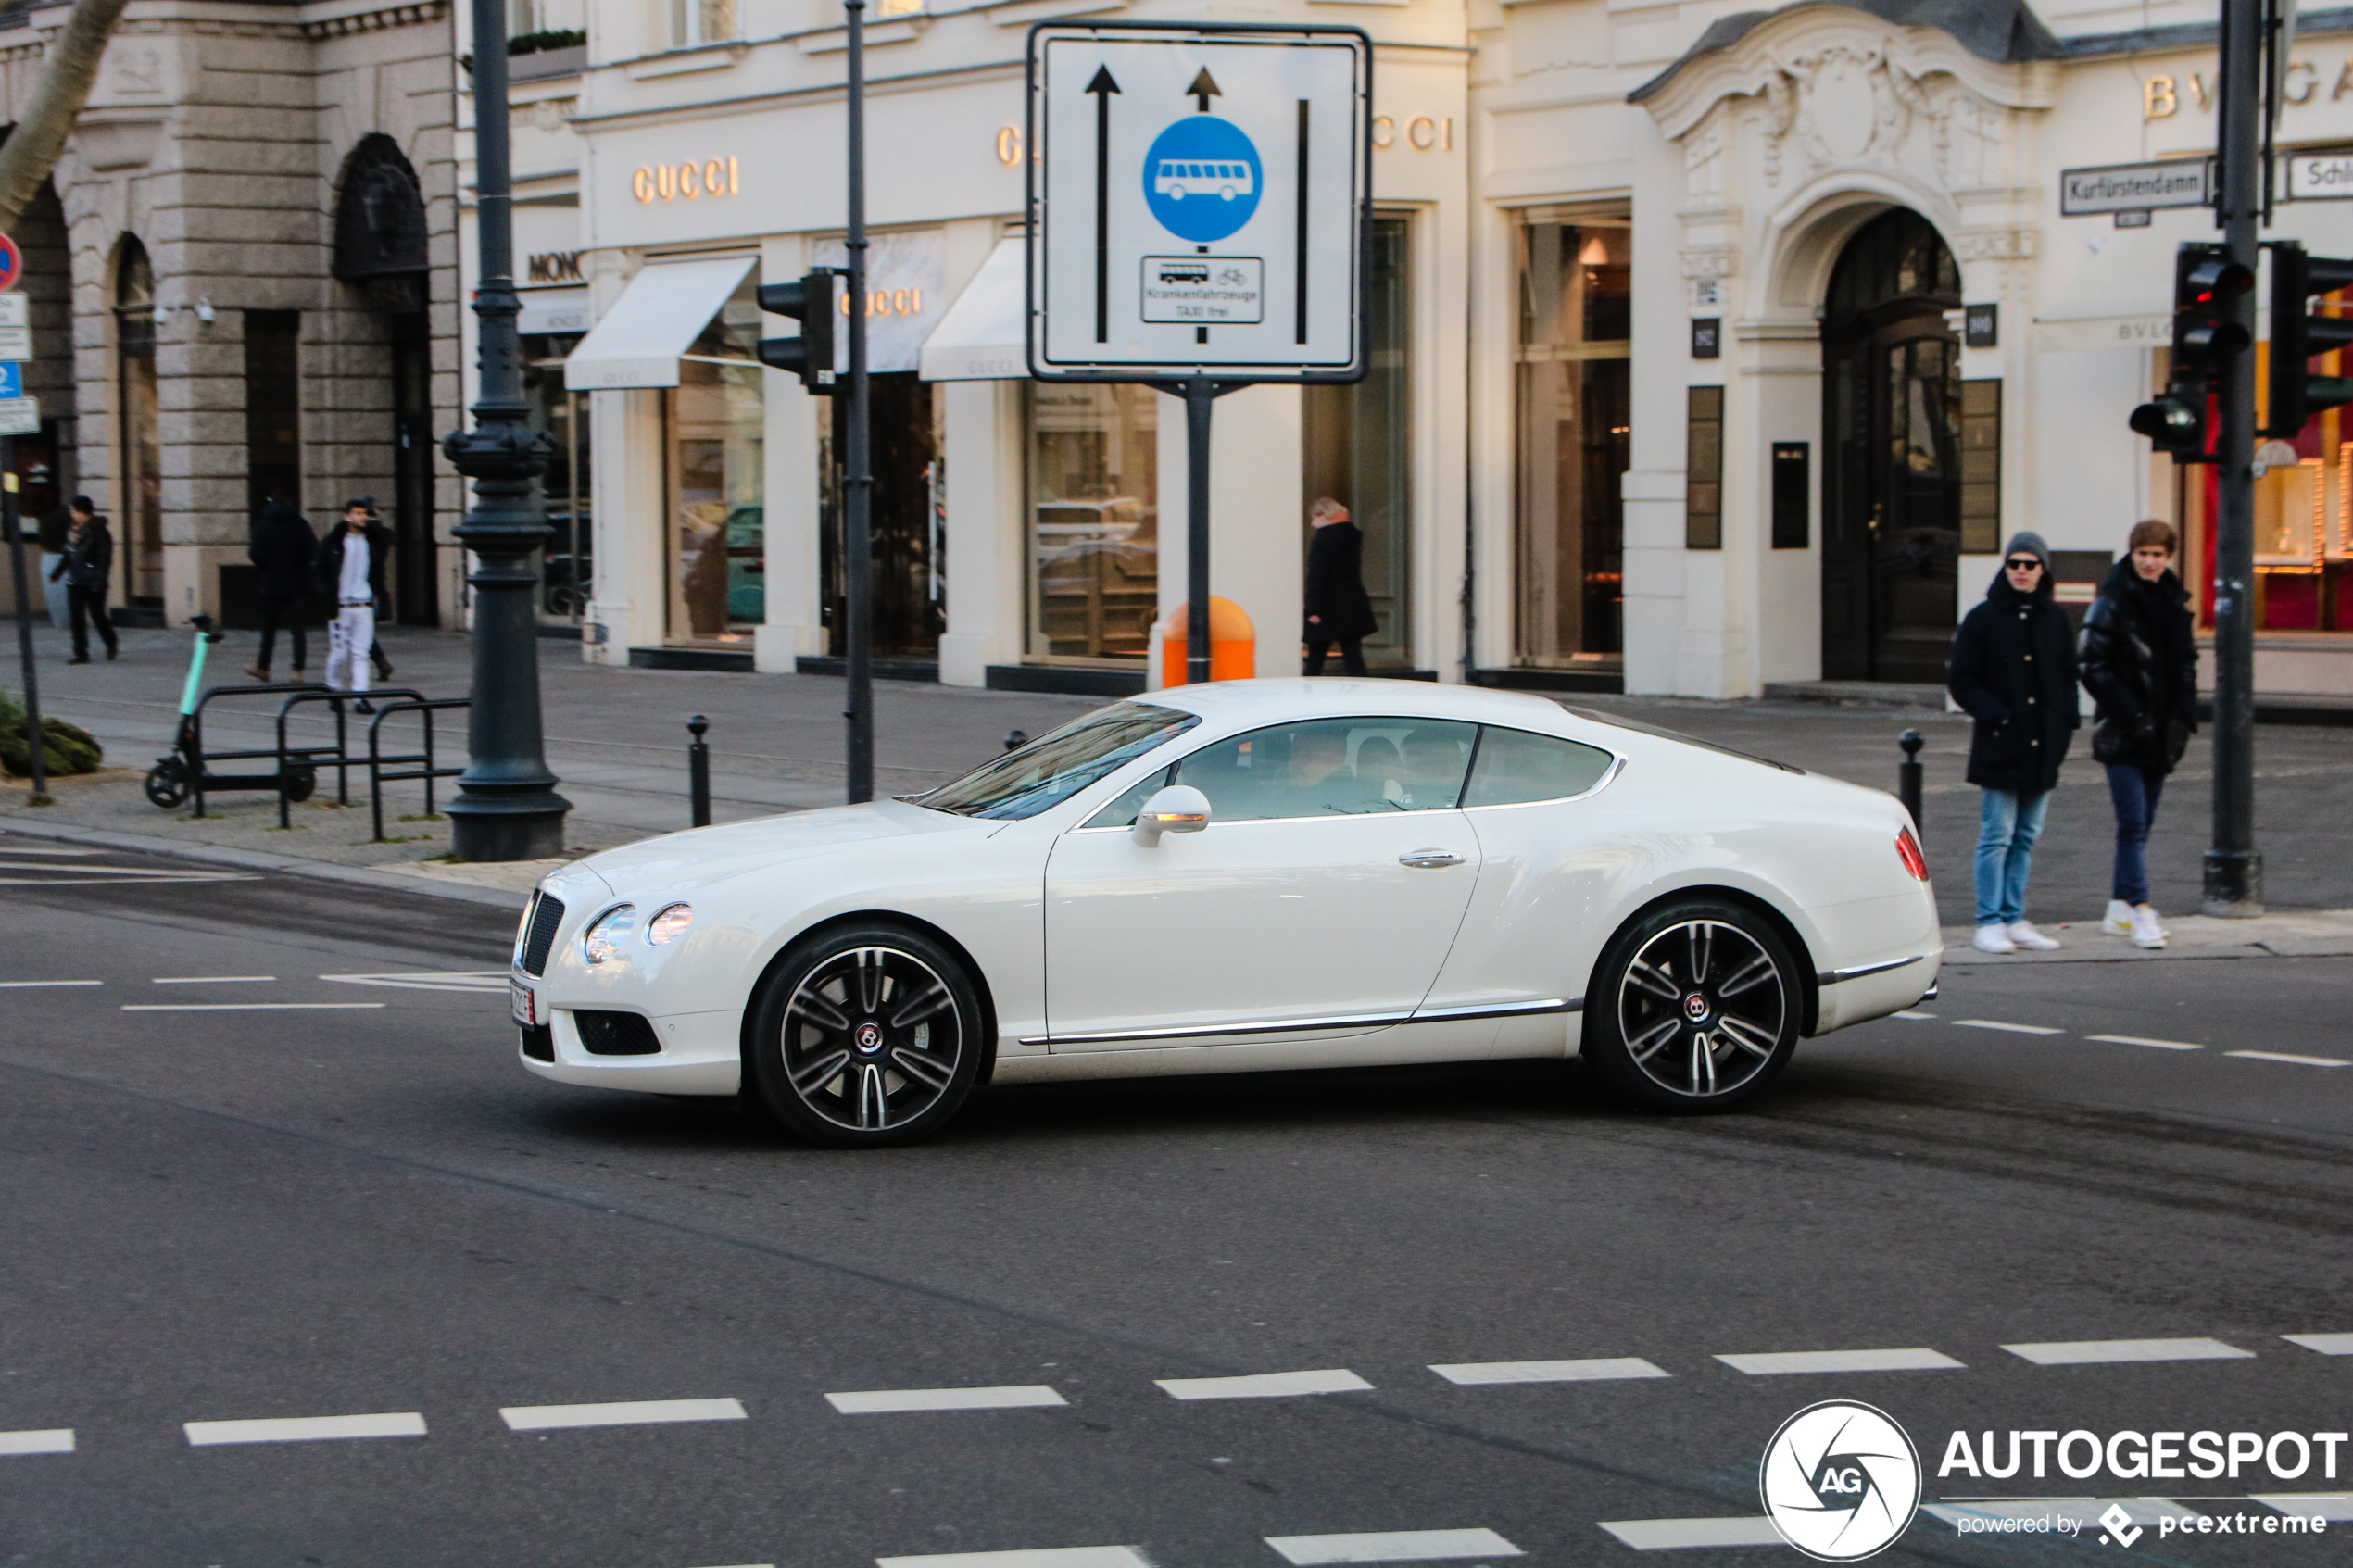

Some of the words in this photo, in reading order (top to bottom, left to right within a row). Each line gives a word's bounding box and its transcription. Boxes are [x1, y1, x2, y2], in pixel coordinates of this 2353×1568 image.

[2144, 56, 2353, 120] BVGA
[635, 157, 738, 204] GUCCI
[2070, 173, 2198, 199] Kurfürstendamm
[1147, 289, 1257, 302] Krankenfahrzeuge
[1176, 306, 1202, 317] TAXI
[1208, 306, 1229, 317] frei
